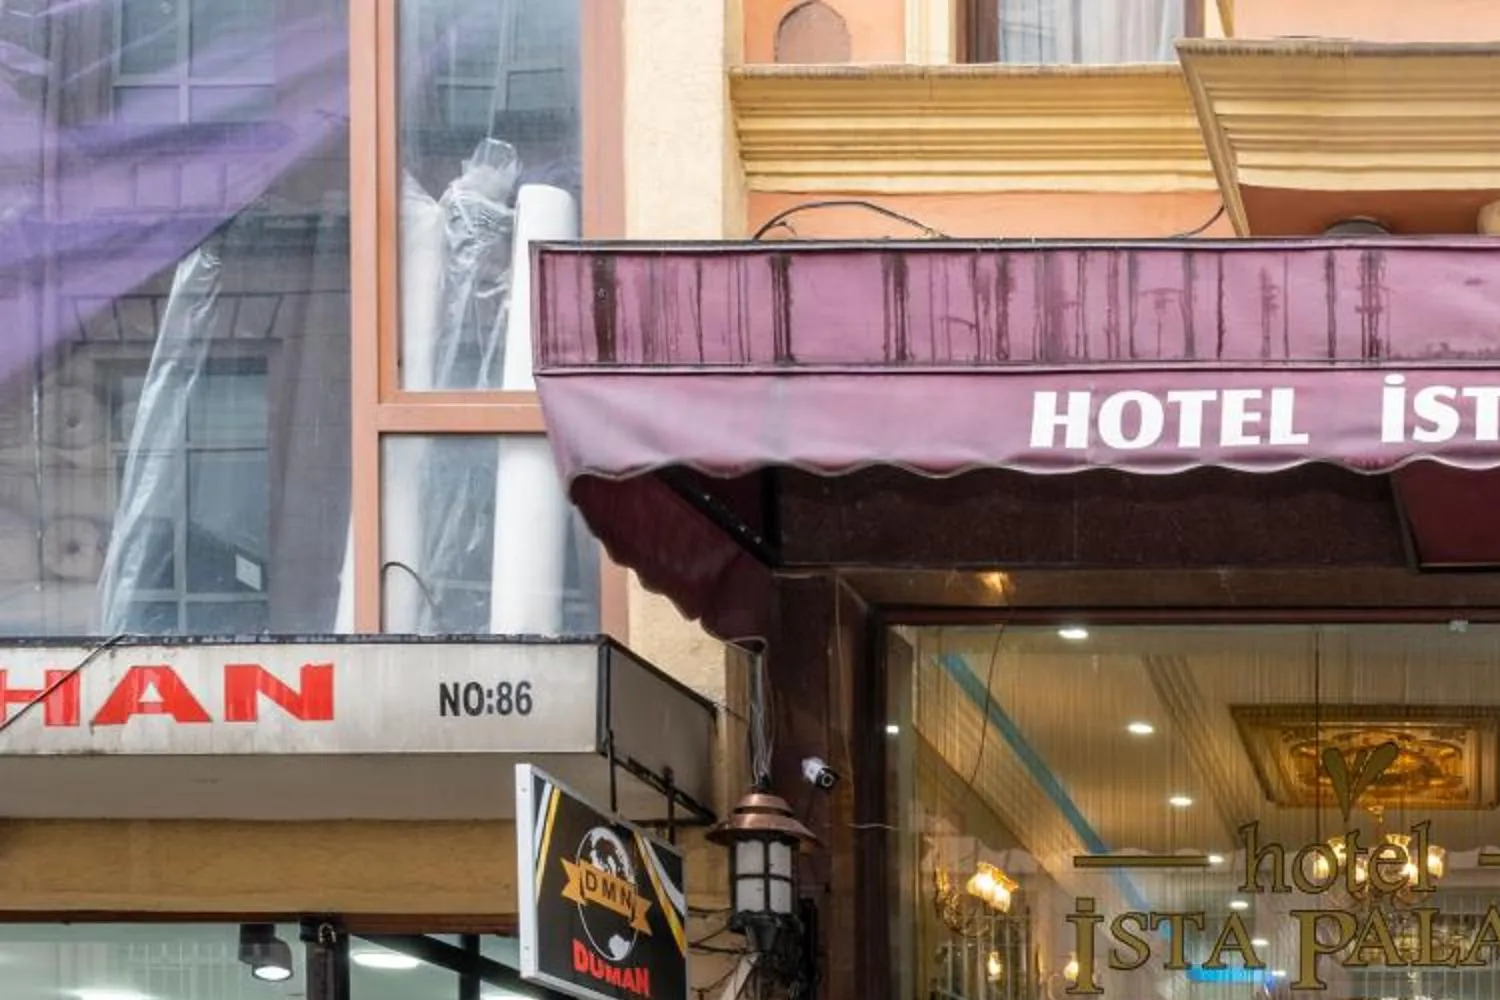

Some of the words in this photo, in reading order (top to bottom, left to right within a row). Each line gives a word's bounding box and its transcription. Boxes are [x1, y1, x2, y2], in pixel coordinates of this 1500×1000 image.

[1029, 387, 1308, 449] HOTEL
[439, 681, 533, 717] NO:86
[1237, 819, 1437, 895] hotel
[584, 866, 633, 909] DMN
[572, 938, 649, 995] DUMAN
[1065, 897, 1267, 995] İSTA
